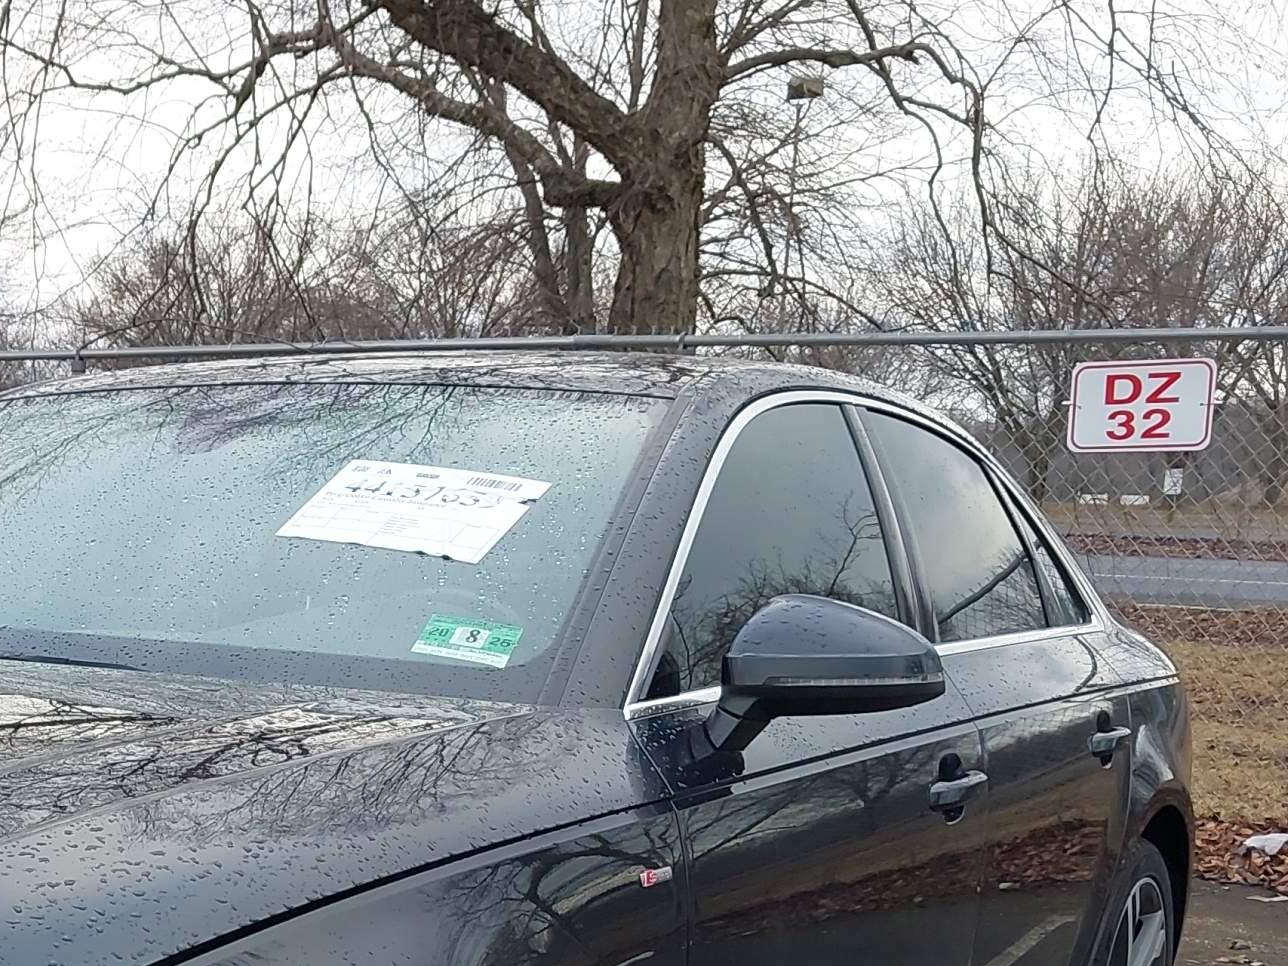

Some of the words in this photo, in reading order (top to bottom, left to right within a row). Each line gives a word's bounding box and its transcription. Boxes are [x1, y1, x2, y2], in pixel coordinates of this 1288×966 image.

[1104, 372, 1182, 405] DZ
[1106, 408, 1172, 440] 32
[465, 629, 481, 643] 8
